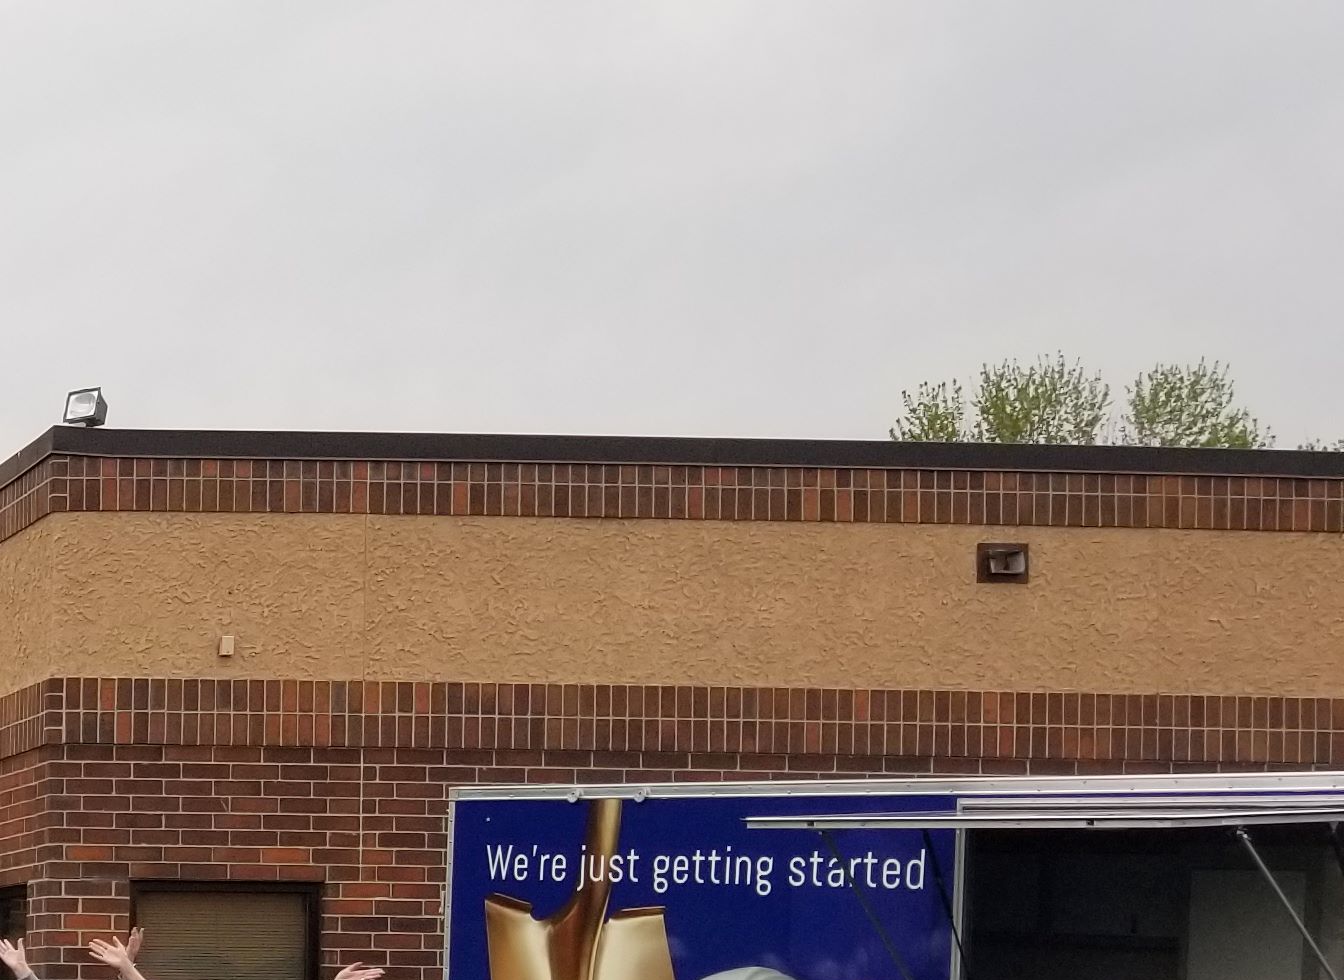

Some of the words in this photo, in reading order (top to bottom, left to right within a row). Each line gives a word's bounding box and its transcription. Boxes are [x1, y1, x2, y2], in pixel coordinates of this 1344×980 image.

[486, 844, 567, 882] We're
[576, 844, 640, 892] just
[653, 845, 774, 896] getting
[788, 848, 926, 890] started
